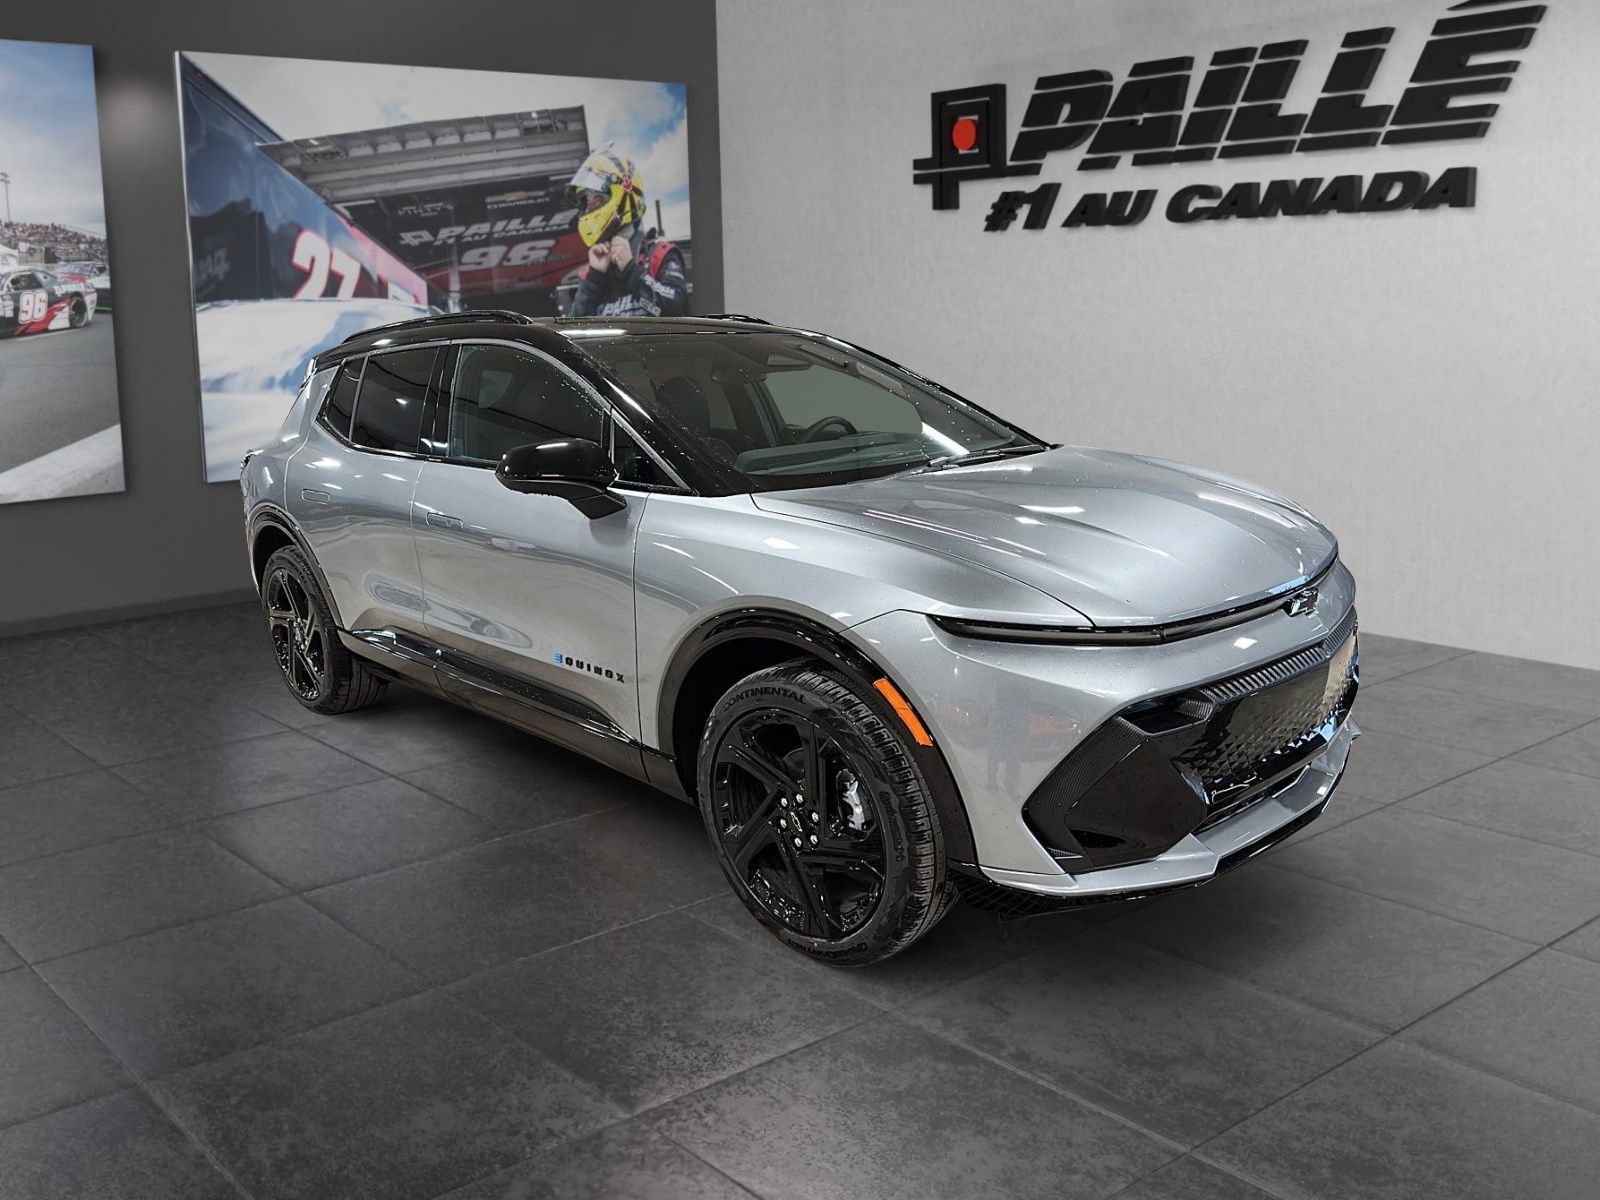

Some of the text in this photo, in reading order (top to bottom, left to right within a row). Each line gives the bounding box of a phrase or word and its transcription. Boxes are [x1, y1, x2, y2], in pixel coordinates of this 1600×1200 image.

[1009, 0, 1548, 171] PAILLÉ
[984, 166, 1478, 231] #1 AU CANADA
[291, 229, 361, 300] 27
[457, 239, 557, 272] 96
[18, 289, 49, 325] 96
[553, 653, 625, 684] EQUINOX
[722, 686, 808, 712] CONTINENTAL
